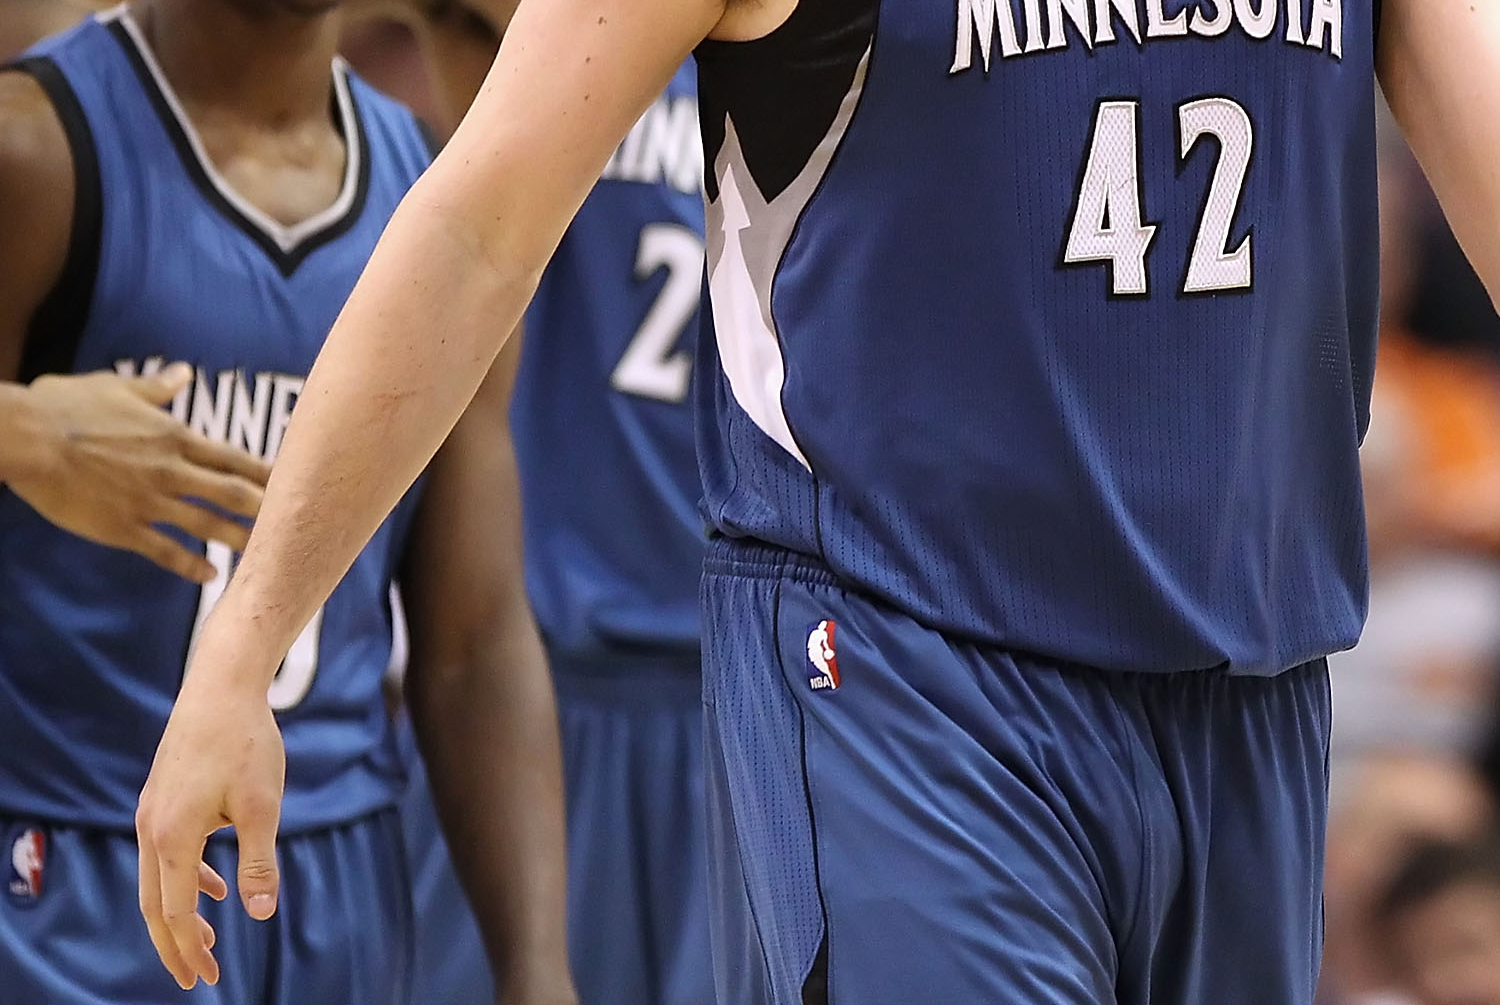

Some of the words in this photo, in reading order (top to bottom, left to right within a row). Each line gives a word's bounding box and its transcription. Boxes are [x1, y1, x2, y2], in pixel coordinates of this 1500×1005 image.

[1062, 97, 1254, 296] 42
[609, 222, 705, 403] 2
[810, 676, 830, 689] NBA
